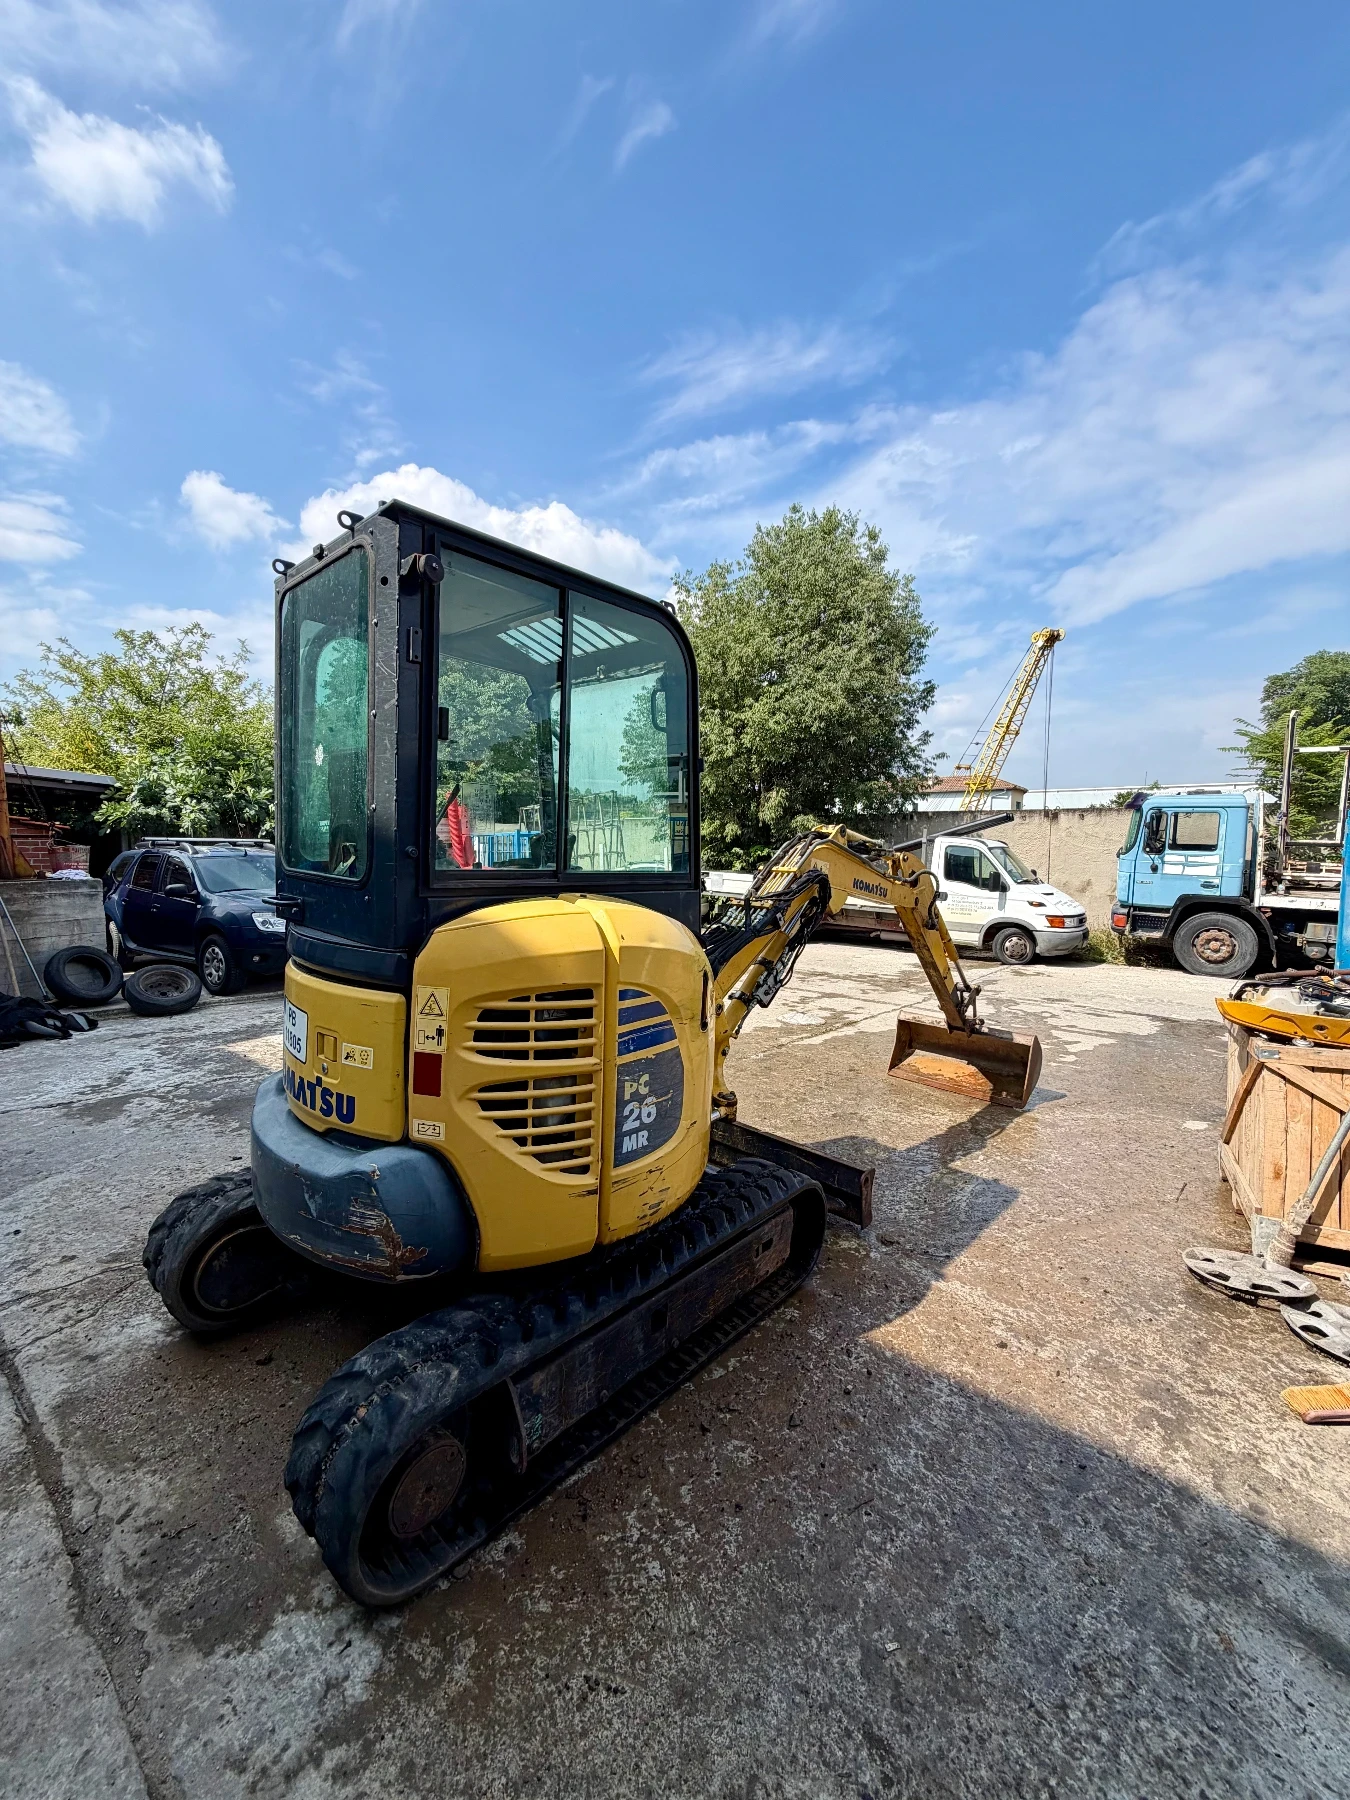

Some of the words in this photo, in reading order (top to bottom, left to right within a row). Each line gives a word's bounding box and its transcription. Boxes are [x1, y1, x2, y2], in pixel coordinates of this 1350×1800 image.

[853, 877, 888, 898] KOMATSU
[284, 1065, 356, 1124] MATSU
[624, 1073, 650, 1100] PC
[621, 1096, 657, 1132] 26
[622, 1129, 649, 1154] MR
